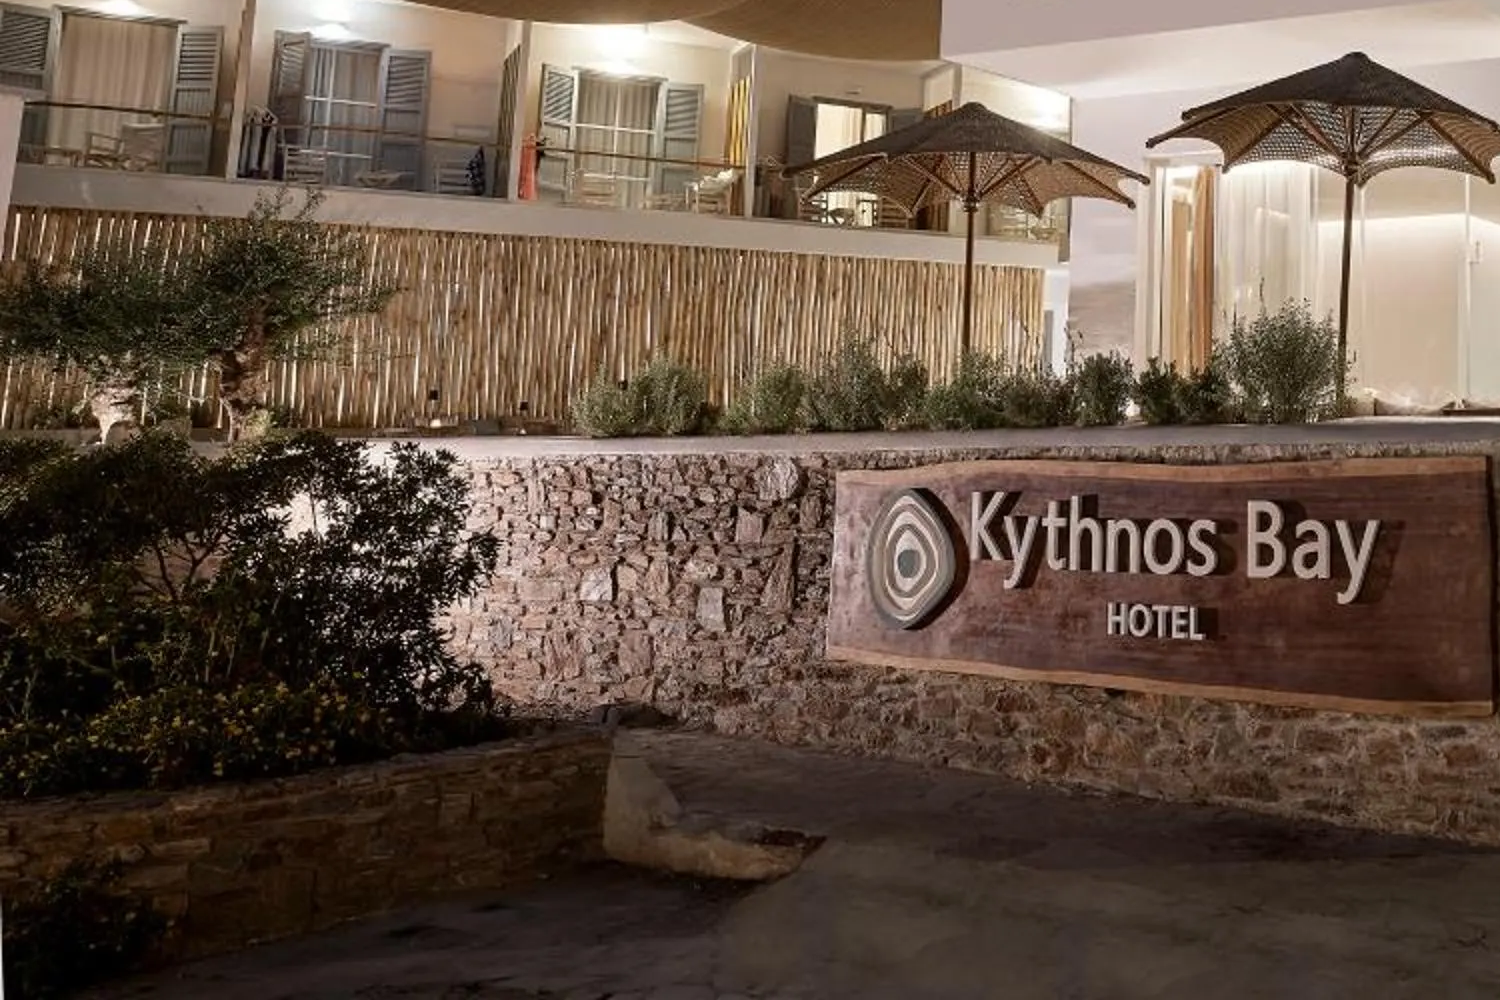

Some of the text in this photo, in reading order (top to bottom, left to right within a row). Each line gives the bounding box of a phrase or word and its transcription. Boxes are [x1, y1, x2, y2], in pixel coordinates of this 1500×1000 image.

[969, 491, 1380, 604] Kythnos Bay
[1106, 602, 1205, 641] HOTEL
